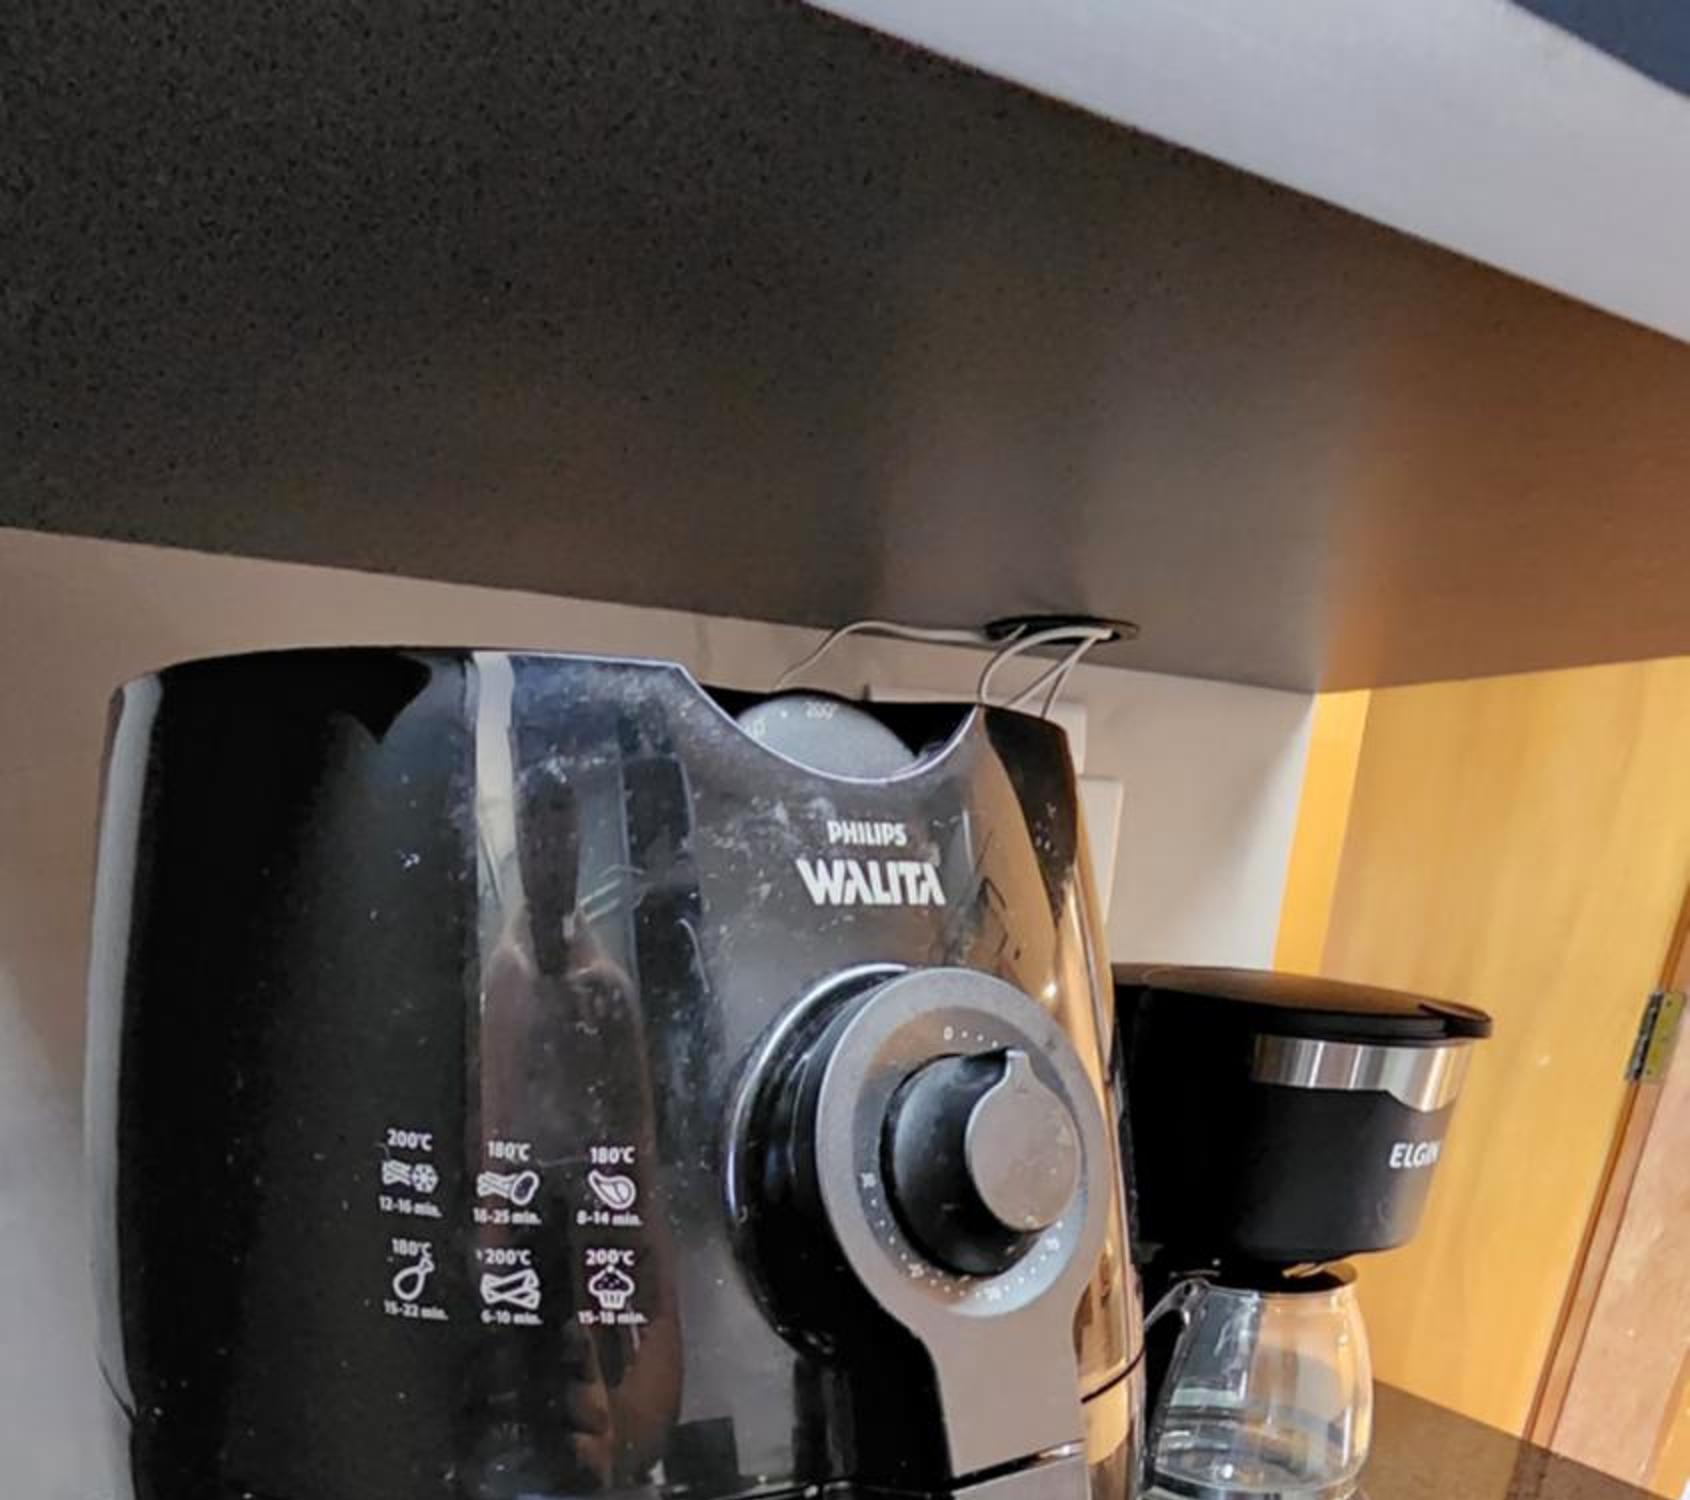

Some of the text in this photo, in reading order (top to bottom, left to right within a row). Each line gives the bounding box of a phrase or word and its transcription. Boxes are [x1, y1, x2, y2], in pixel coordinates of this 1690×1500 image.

[826, 820, 908, 846] PHILIPS
[796, 858, 946, 905] WALITA
[387, 1128, 432, 1151] 200°C
[488, 1141, 531, 1162] 180°C
[590, 1147, 635, 1165] 180°C
[414, 1201, 443, 1219] min.
[511, 1210, 543, 1225] min.
[611, 1211, 644, 1226] min.
[485, 1249, 531, 1266] 200°C
[585, 1249, 635, 1266] 200°C
[421, 1305, 449, 1320] min.
[513, 1311, 544, 1325] min.
[617, 1311, 648, 1324] min.
